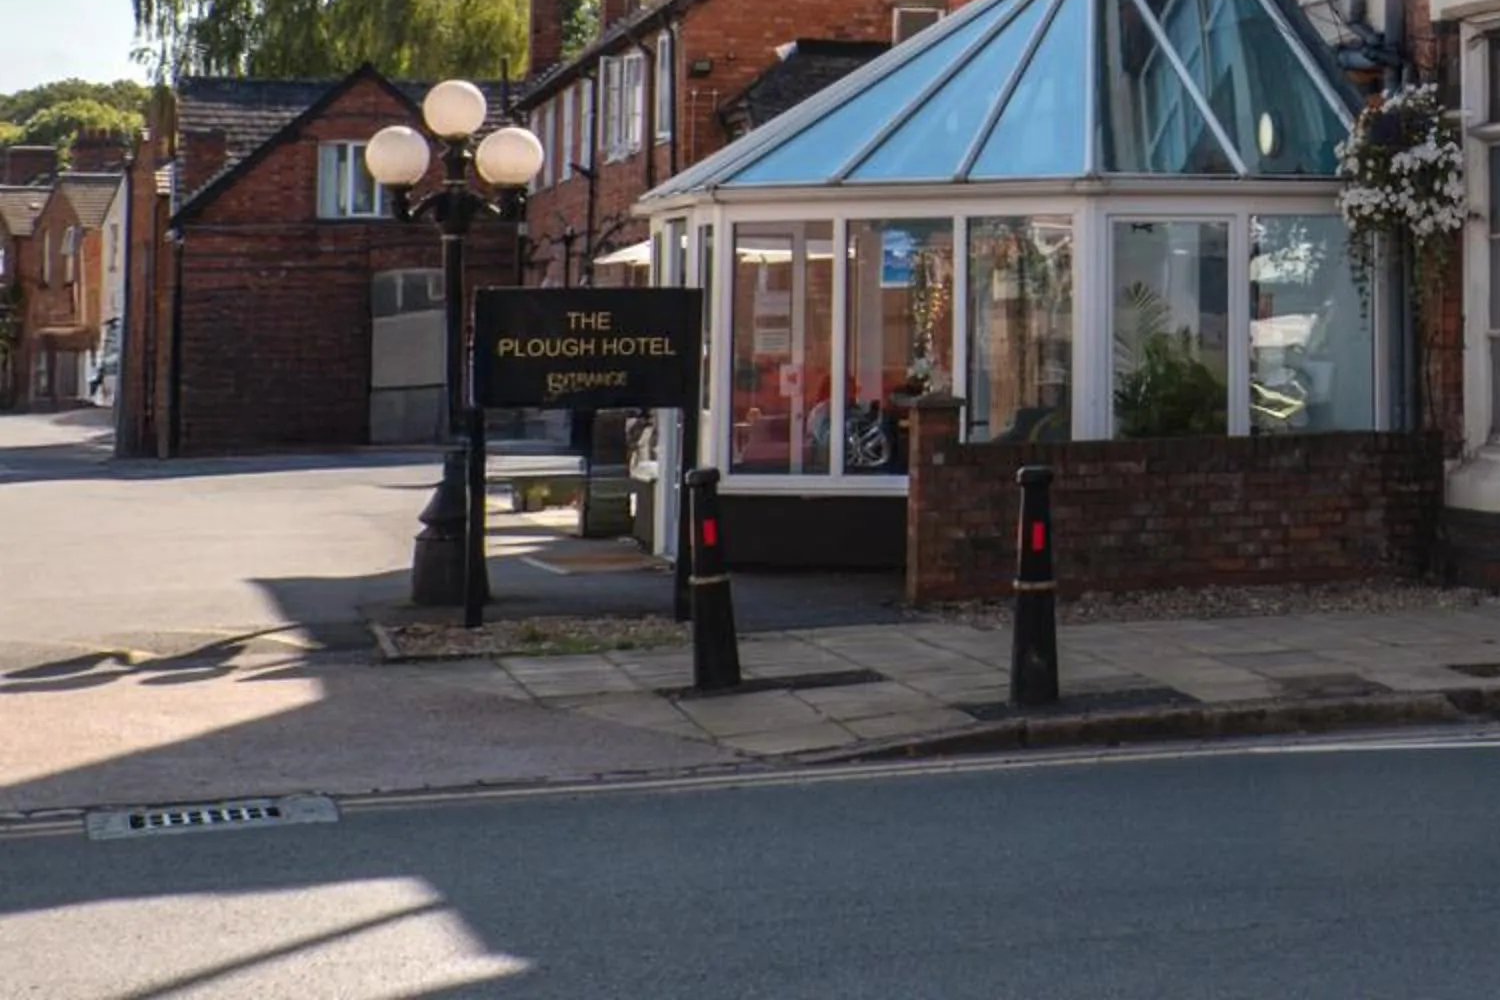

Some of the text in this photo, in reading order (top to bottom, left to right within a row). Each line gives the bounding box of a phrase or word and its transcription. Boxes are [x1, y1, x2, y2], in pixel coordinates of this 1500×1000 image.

[567, 311, 612, 331] THE
[499, 337, 676, 357] PLOUGH HOTEL
